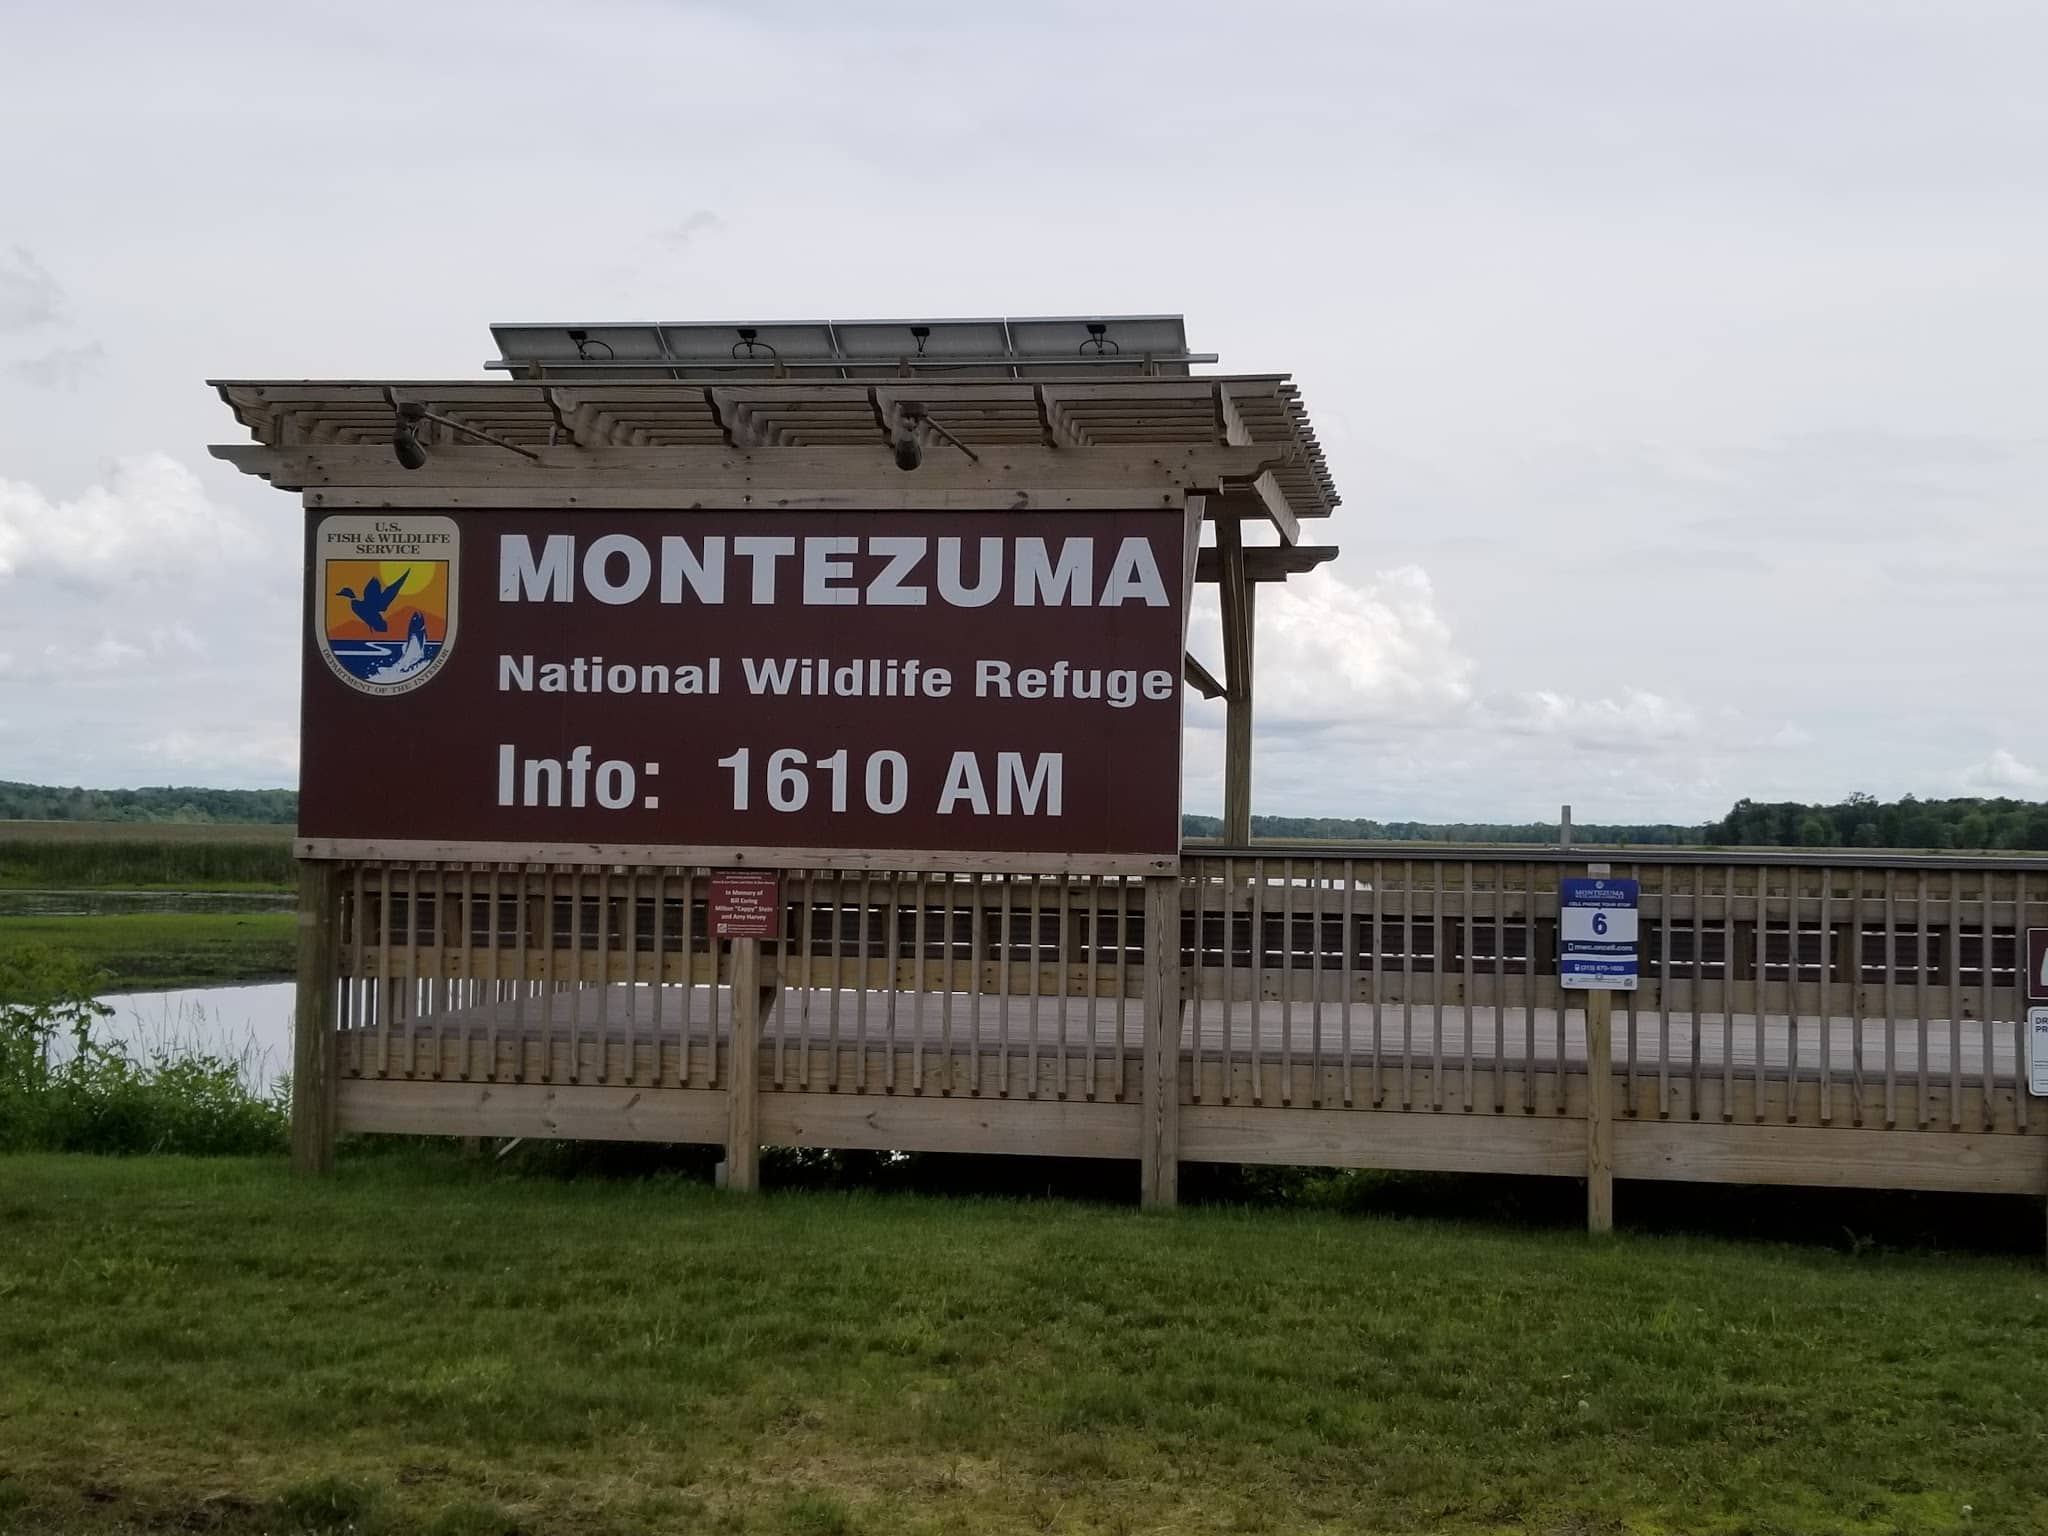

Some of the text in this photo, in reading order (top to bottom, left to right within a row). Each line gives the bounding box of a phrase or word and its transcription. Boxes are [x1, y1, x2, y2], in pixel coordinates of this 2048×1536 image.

[327, 533, 450, 544] FISH & WILDLIFE
[375, 522, 402, 533] U.S.
[356, 544, 421, 554] SERVICE
[499, 534, 1170, 609] MONTEZUMA
[322, 648, 374, 692] DEPARTMENT
[391, 684, 412, 694] THE
[414, 648, 450, 686] INTERIOR
[499, 655, 1173, 708] National Wildlife Refuge
[498, 744, 1063, 816] Info: 1610 AM
[1592, 912, 1608, 935] 6
